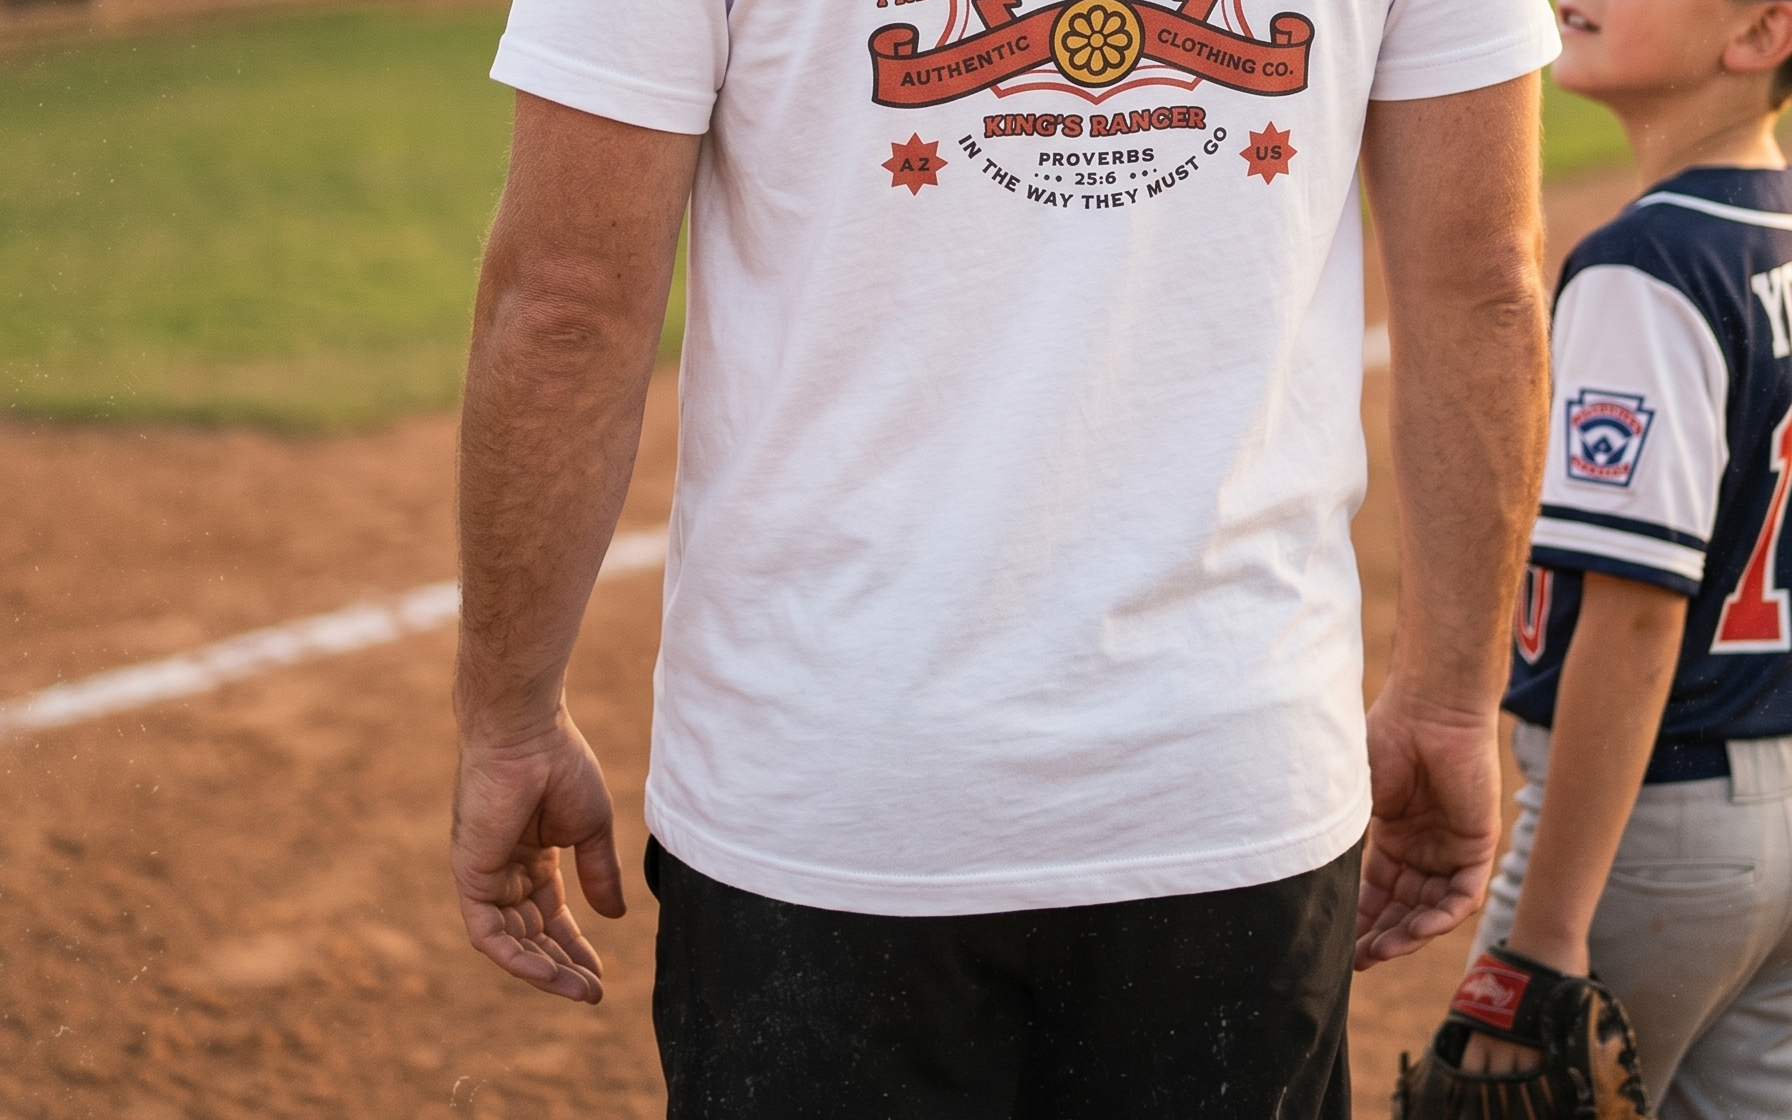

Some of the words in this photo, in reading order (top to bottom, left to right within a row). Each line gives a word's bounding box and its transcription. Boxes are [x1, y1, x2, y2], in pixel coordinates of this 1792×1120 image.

[900, 35, 1030, 87] AUTHENTIC
[1157, 28, 1257, 75] CLOTHING
[1262, 61, 1295, 77] CO.
[983, 113, 1084, 139] KING'S
[1038, 147, 1155, 167] PROVERBS
[1255, 145, 1283, 161] US
[958, 133, 982, 160] IN
[982, 157, 1018, 193] THE
[1026, 184, 1074, 208] WAY
[1081, 188, 1138, 210] THEY
[1146, 155, 1199, 198] MUST
[1203, 126, 1227, 155] GO
[1074, 171, 1117, 186] 25:6
